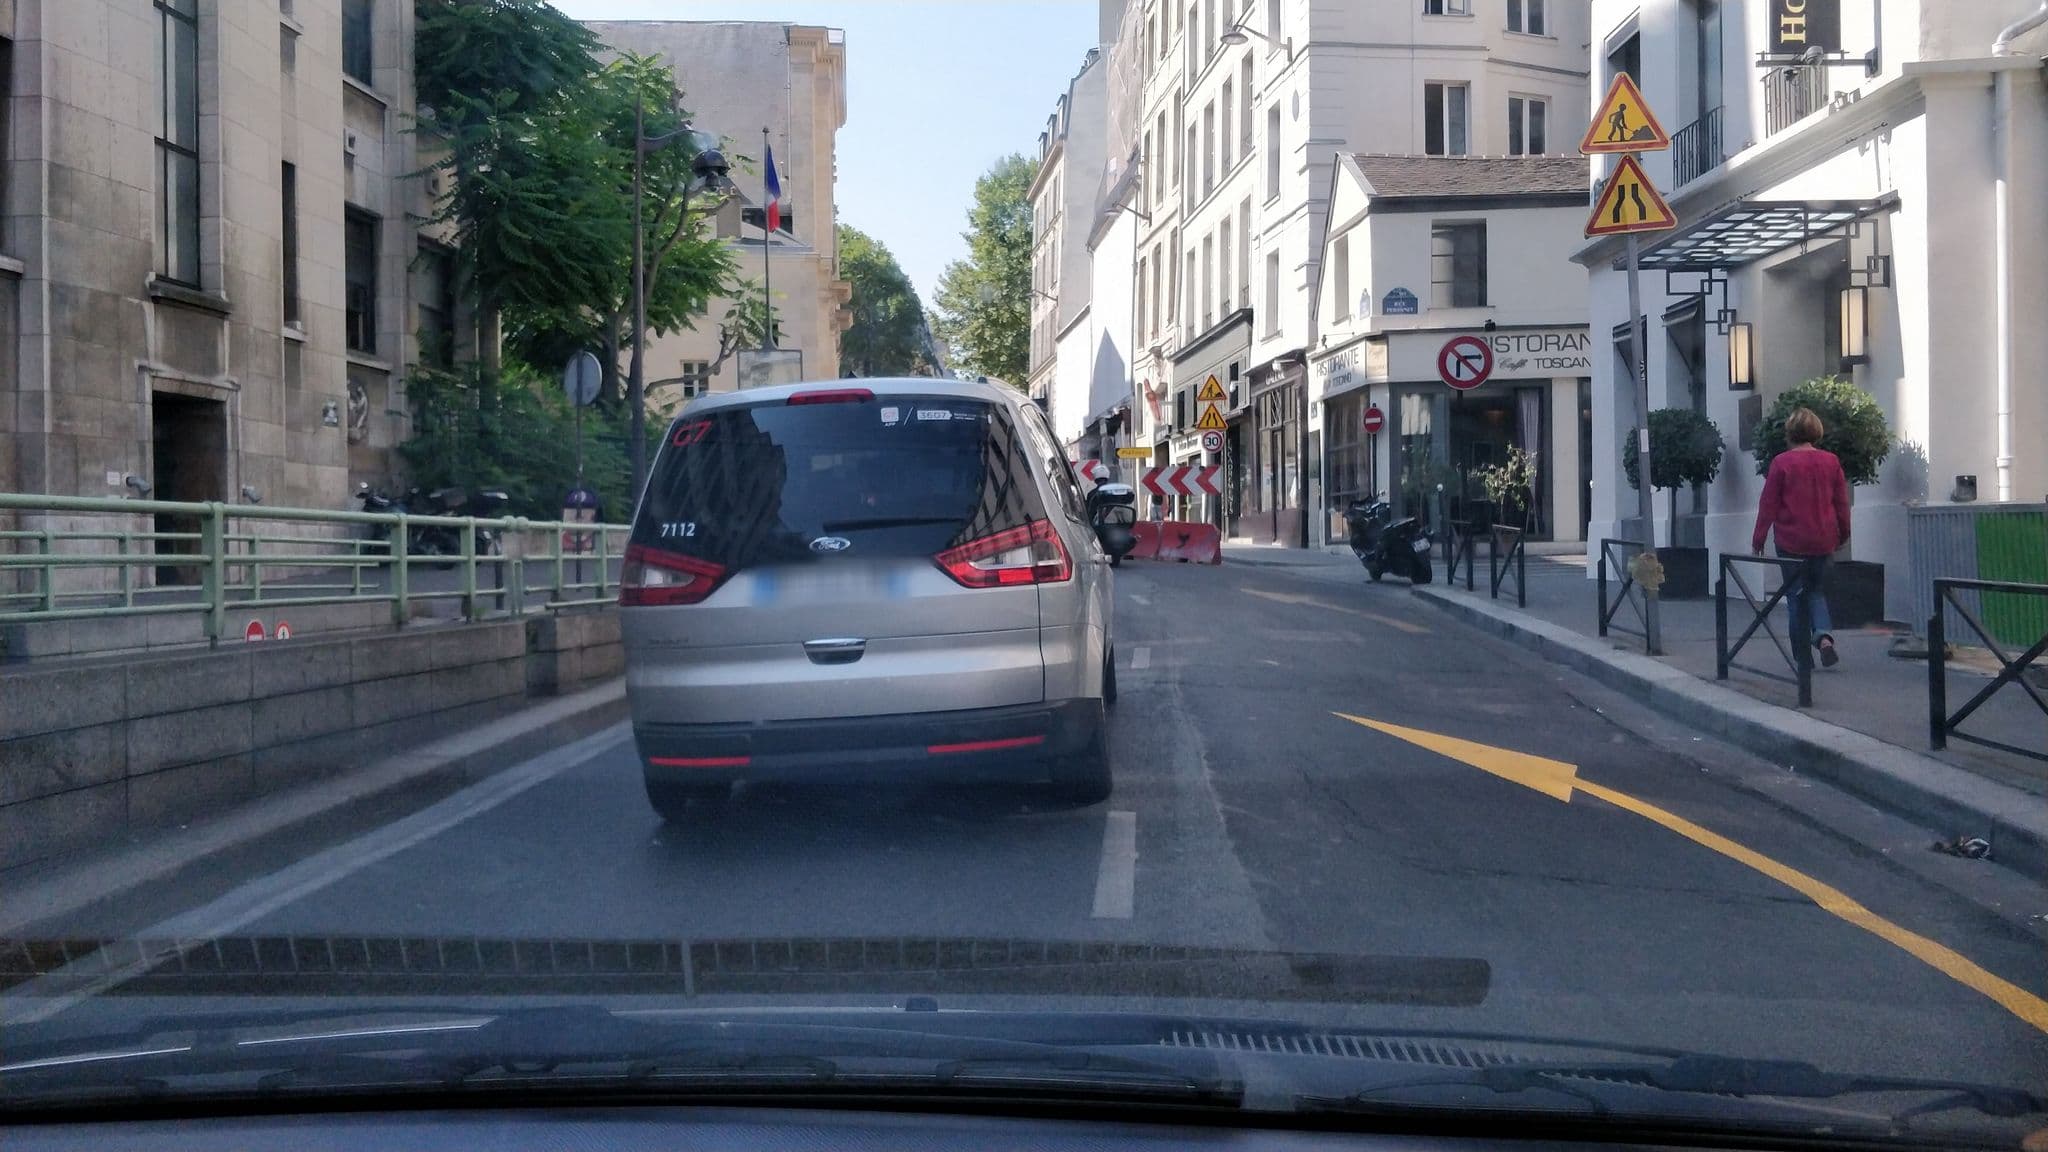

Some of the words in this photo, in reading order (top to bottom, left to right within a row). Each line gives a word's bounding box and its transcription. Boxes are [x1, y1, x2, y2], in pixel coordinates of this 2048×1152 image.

[672, 420, 712, 447] G7
[1206, 436, 1219, 447] 30
[661, 522, 696, 538] 7112
